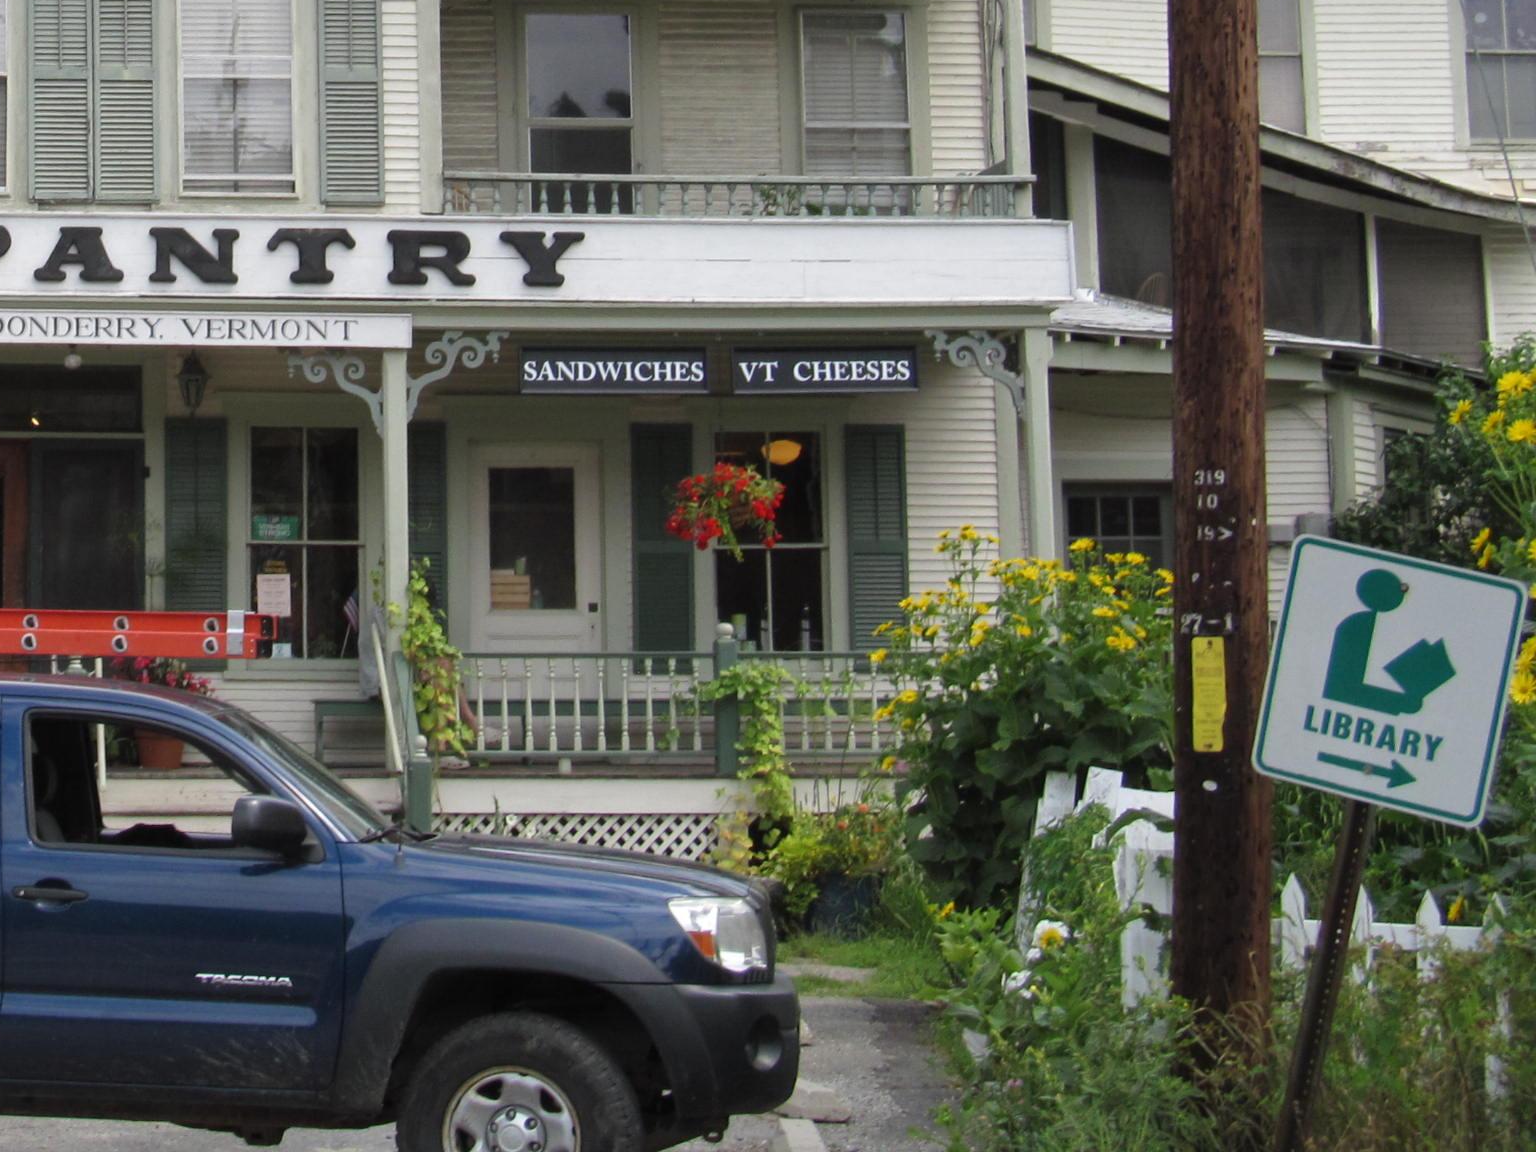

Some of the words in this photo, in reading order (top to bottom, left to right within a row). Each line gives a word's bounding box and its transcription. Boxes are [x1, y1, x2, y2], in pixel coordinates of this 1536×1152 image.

[181, 318, 359, 341] VERMONT
[524, 360, 704, 382] SANDWICHES
[739, 361, 778, 383] VT
[793, 360, 910, 382] CHEESES
[1194, 469, 1225, 486] 319
[1197, 493, 1218, 510] 10
[1303, 704, 1444, 761] LIBRARY
[195, 973, 293, 987] TACOMA
